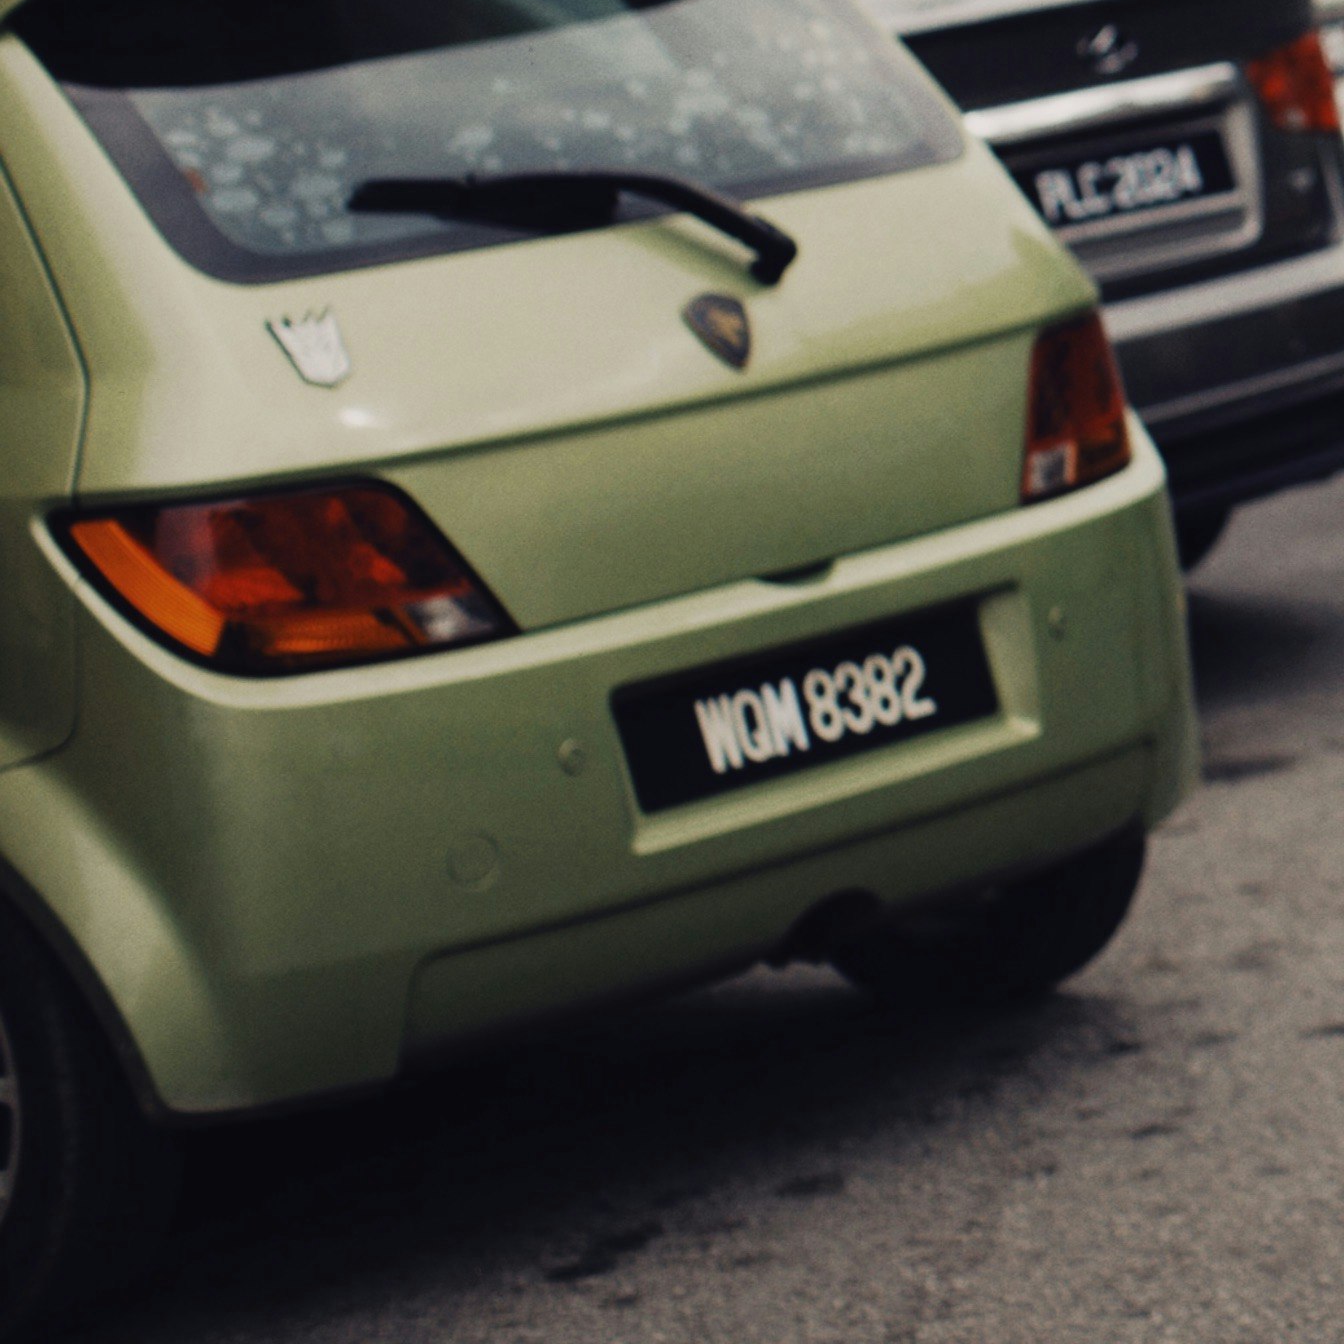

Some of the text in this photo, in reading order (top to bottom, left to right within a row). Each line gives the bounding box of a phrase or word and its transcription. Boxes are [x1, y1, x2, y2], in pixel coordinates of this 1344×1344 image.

[1034, 161, 1113, 223] PLC
[694, 645, 937, 774] WQM 8382
